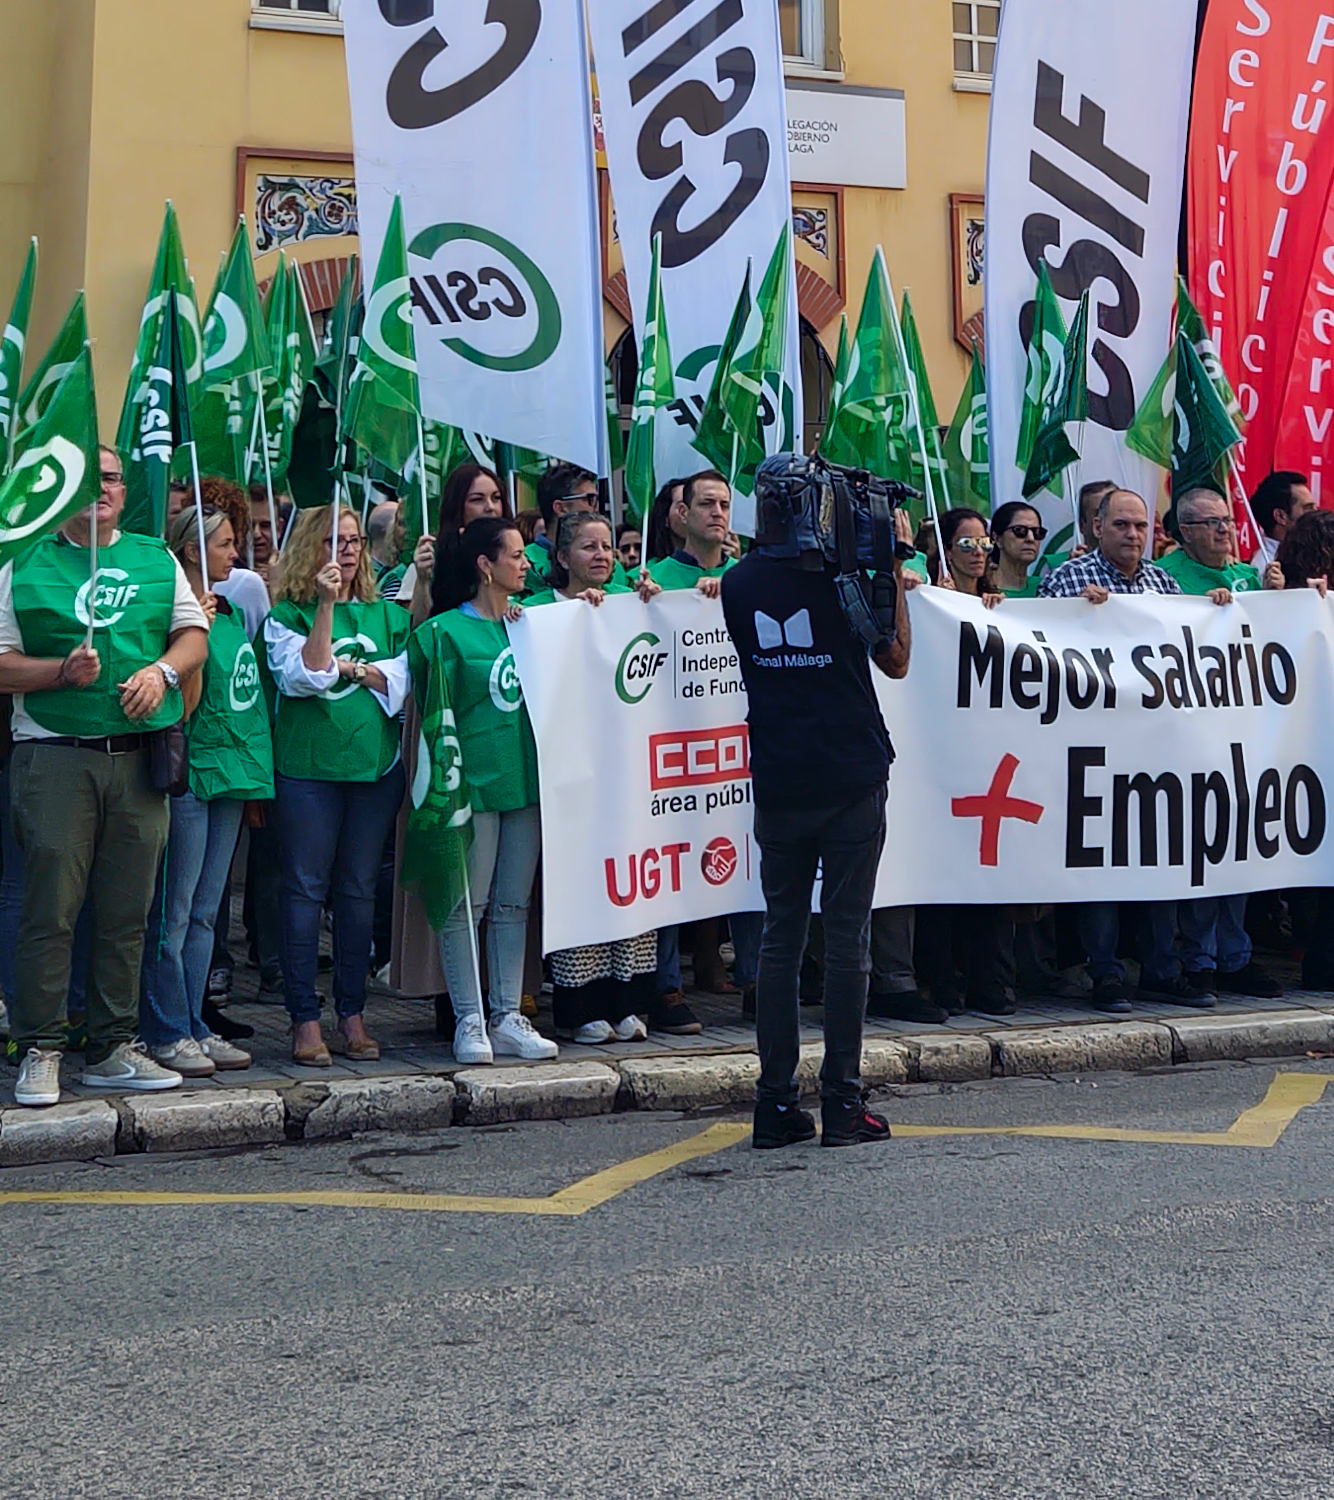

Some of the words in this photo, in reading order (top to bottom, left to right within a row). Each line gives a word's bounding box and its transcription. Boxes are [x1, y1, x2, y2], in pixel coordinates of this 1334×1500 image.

[787, 119, 838, 132] LEGACIÓN
[787, 131, 830, 143] OBIERNO
[788, 144, 814, 153] LAGA
[1019, 59, 1151, 430] CSIF
[627, 652, 669, 680] CSIF
[682, 654, 738, 675] Indepe
[752, 653, 782, 668] Canal
[784, 651, 833, 668] Málaga
[957, 621, 1117, 725] Mejor
[1133, 623, 1298, 712] salario
[682, 682, 704, 699] de
[651, 793, 698, 817] área
[706, 782, 751, 815] públ
[1065, 741, 1327, 887] Empleo
[604, 842, 691, 907] UGT
